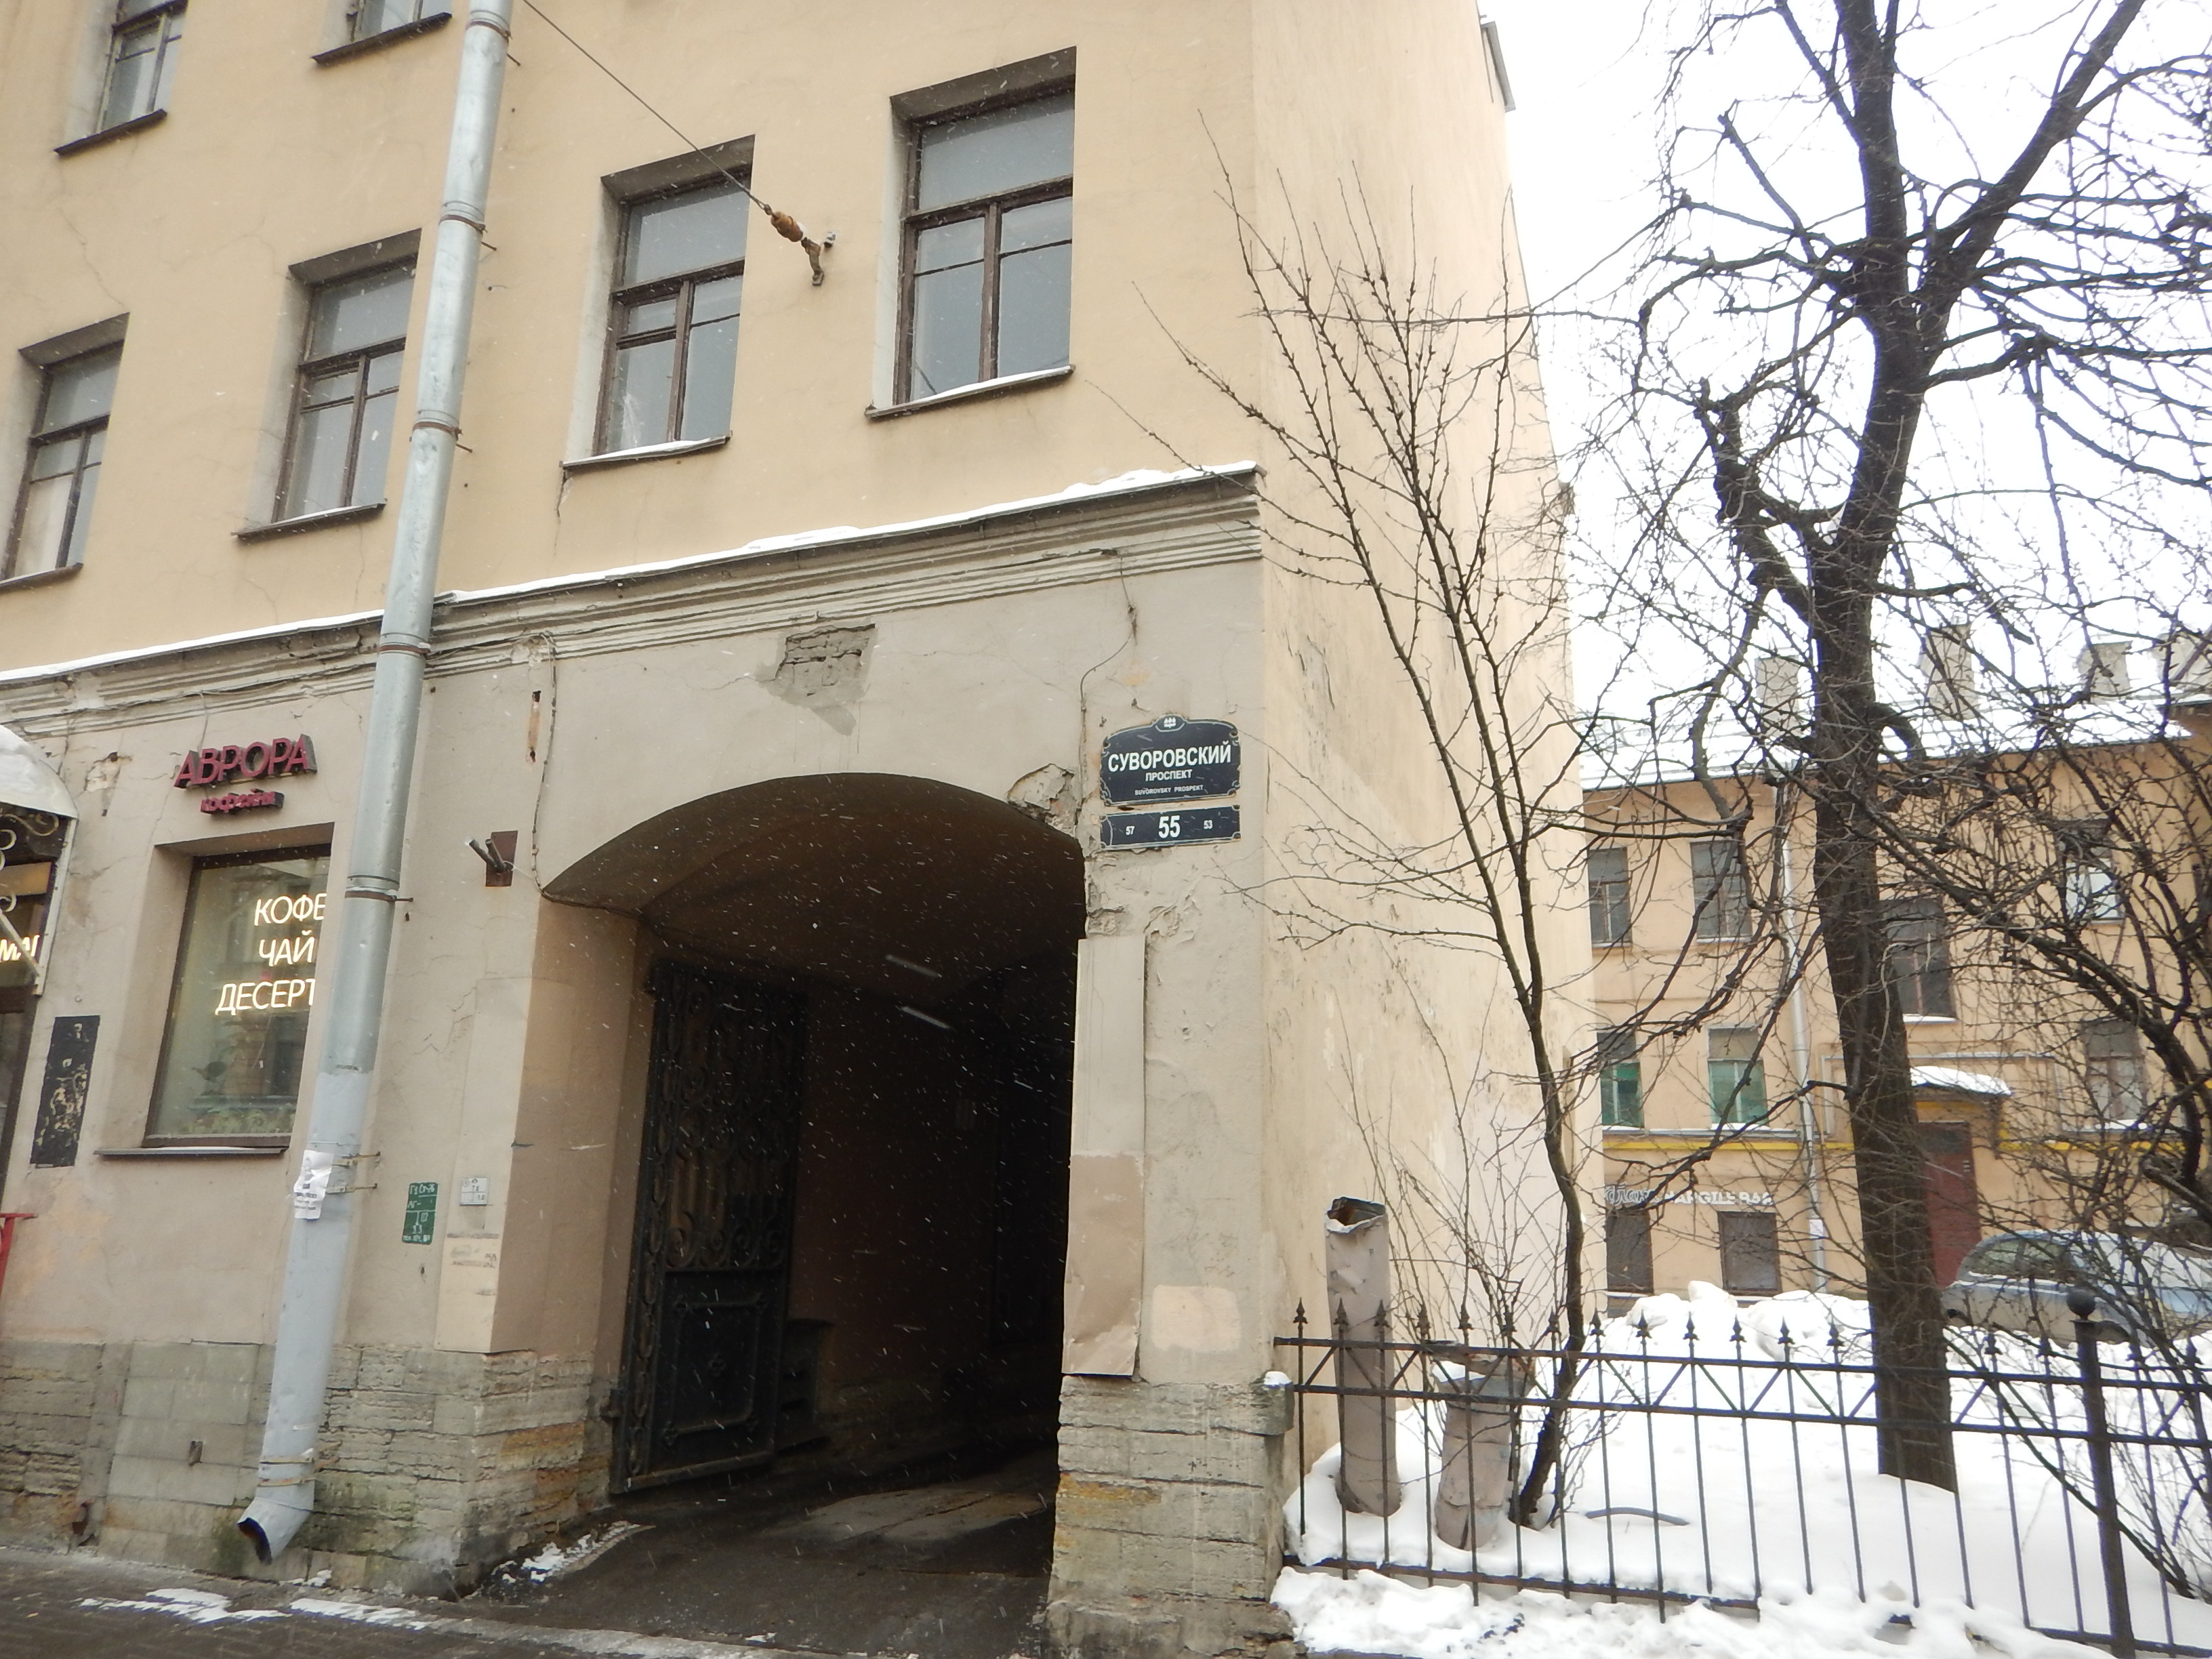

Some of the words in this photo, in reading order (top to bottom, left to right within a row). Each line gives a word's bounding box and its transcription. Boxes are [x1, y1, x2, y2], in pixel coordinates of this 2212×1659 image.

[173, 734, 316, 787] АВРОРА
[1108, 740, 1231, 772] СУВОРОВСКИЙ
[1145, 769, 1193, 781] ПРОСПЕКТ
[1174, 784, 1204, 792] PROSPEKT
[1158, 815, 1181, 838] 55
[254, 893, 327, 926] КОФЕ
[259, 930, 315, 967] ЧАЙ
[215, 979, 316, 1016] ДЕСЕРТ
